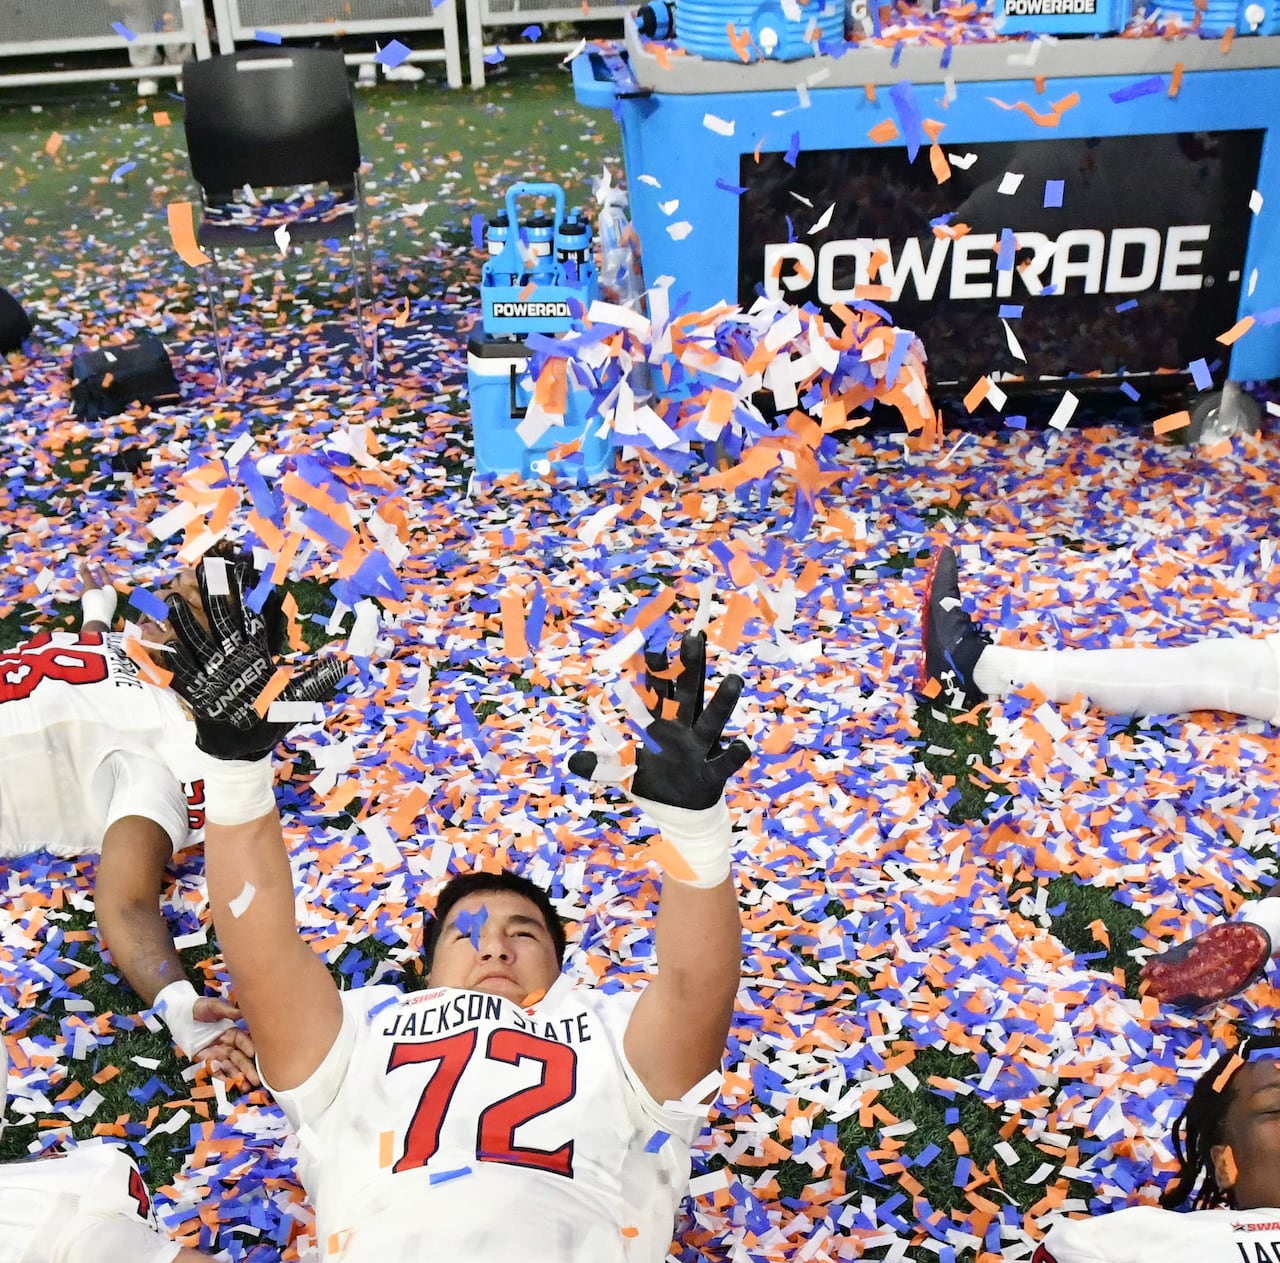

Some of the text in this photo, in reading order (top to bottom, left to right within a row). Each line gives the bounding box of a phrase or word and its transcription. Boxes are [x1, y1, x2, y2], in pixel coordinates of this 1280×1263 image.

[764, 224, 1211, 304] POWERADE
[494, 303, 571, 317] POWERAD
[205, 657, 269, 718] UNDER
[383, 994, 592, 1044] JACKSON STATE
[386, 1027, 577, 1179] 72
